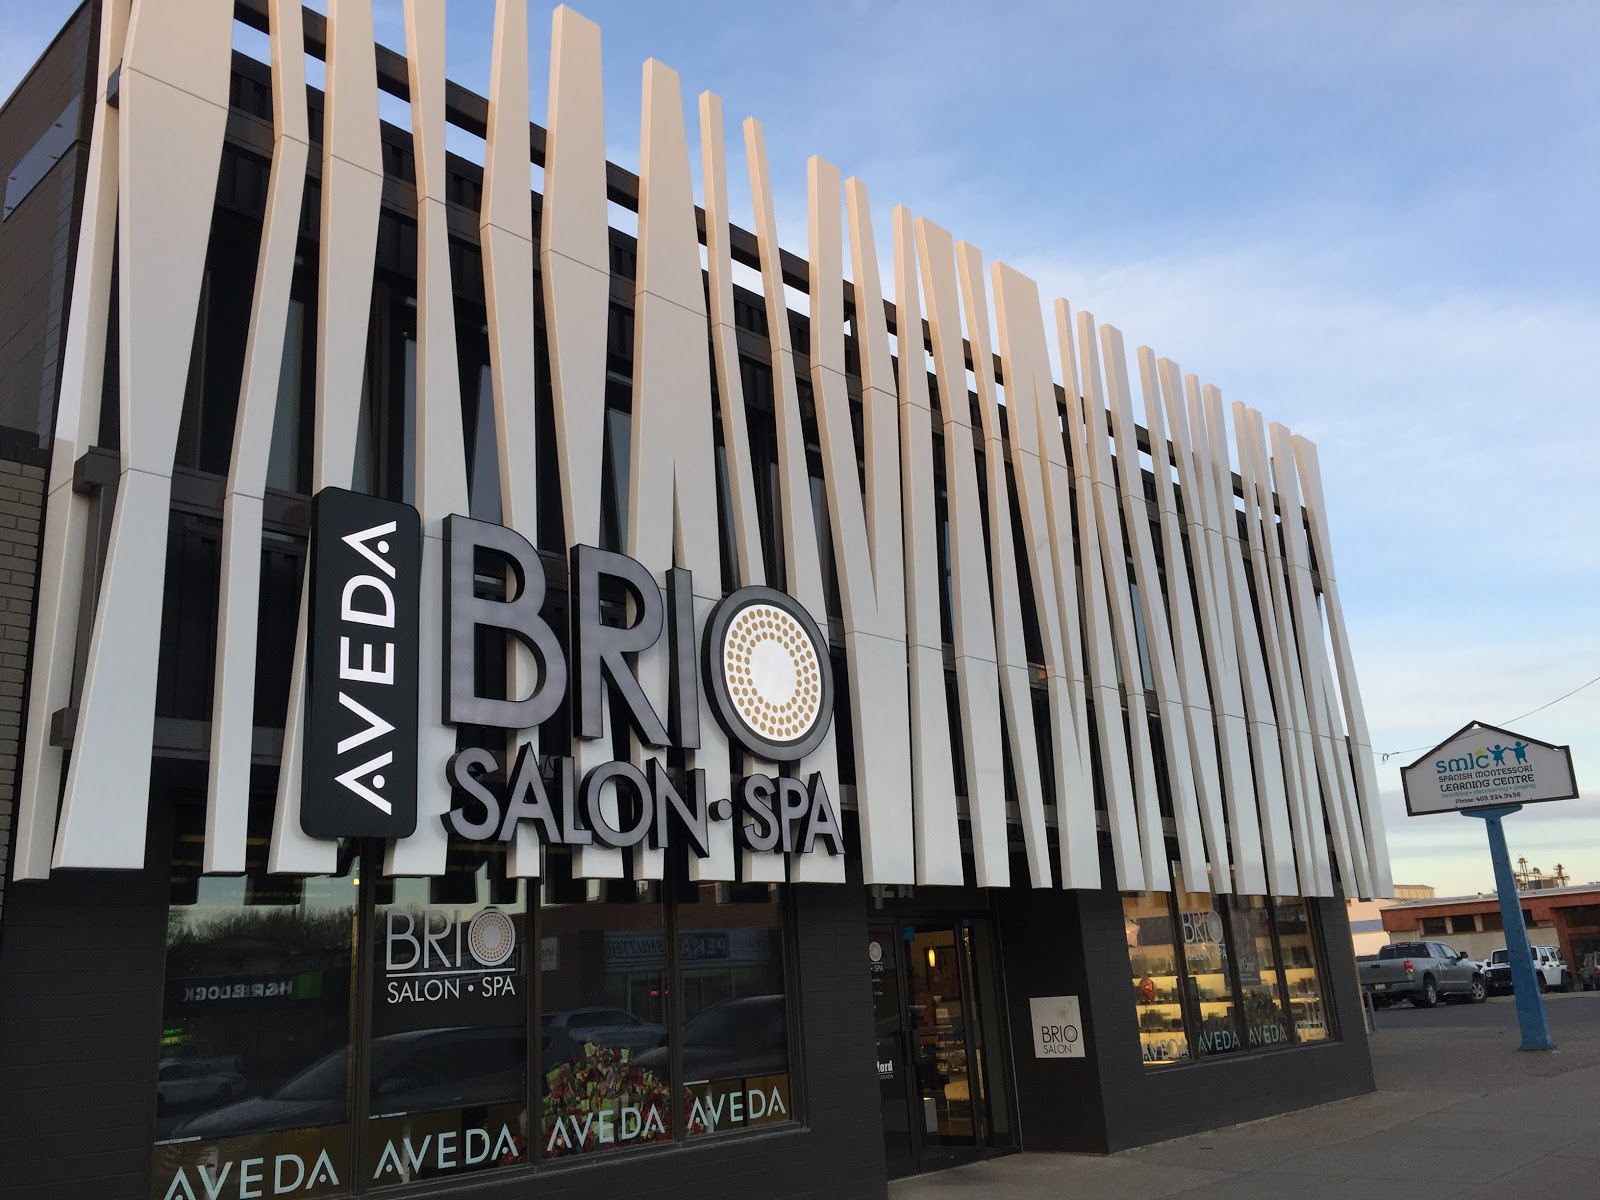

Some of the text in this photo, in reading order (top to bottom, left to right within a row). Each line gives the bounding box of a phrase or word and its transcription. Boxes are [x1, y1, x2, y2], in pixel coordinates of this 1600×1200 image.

[442, 513, 834, 761] BRIO
[334, 520, 397, 815] AVEDA
[1439, 772, 1473, 783] SPANISH
[1440, 774, 1535, 792] LEARNING CENTRE
[440, 743, 846, 858] SALON SPA
[385, 906, 516, 971] BRIO
[1181, 910, 1224, 943] BRIO
[387, 976, 516, 1004] SALON SPA
[1041, 1025, 1078, 1043] BRIO
[1043, 1044, 1072, 1054] SALON
[1142, 1038, 1190, 1061] AVEDA
[1199, 1028, 1240, 1052] AVEDA
[1250, 1023, 1288, 1045] AVEDA
[686, 1085, 787, 1130] AVEDA
[546, 1103, 666, 1152] AVEDA
[373, 1123, 520, 1180] AVEDA
[163, 1148, 340, 1200] AVEDA
